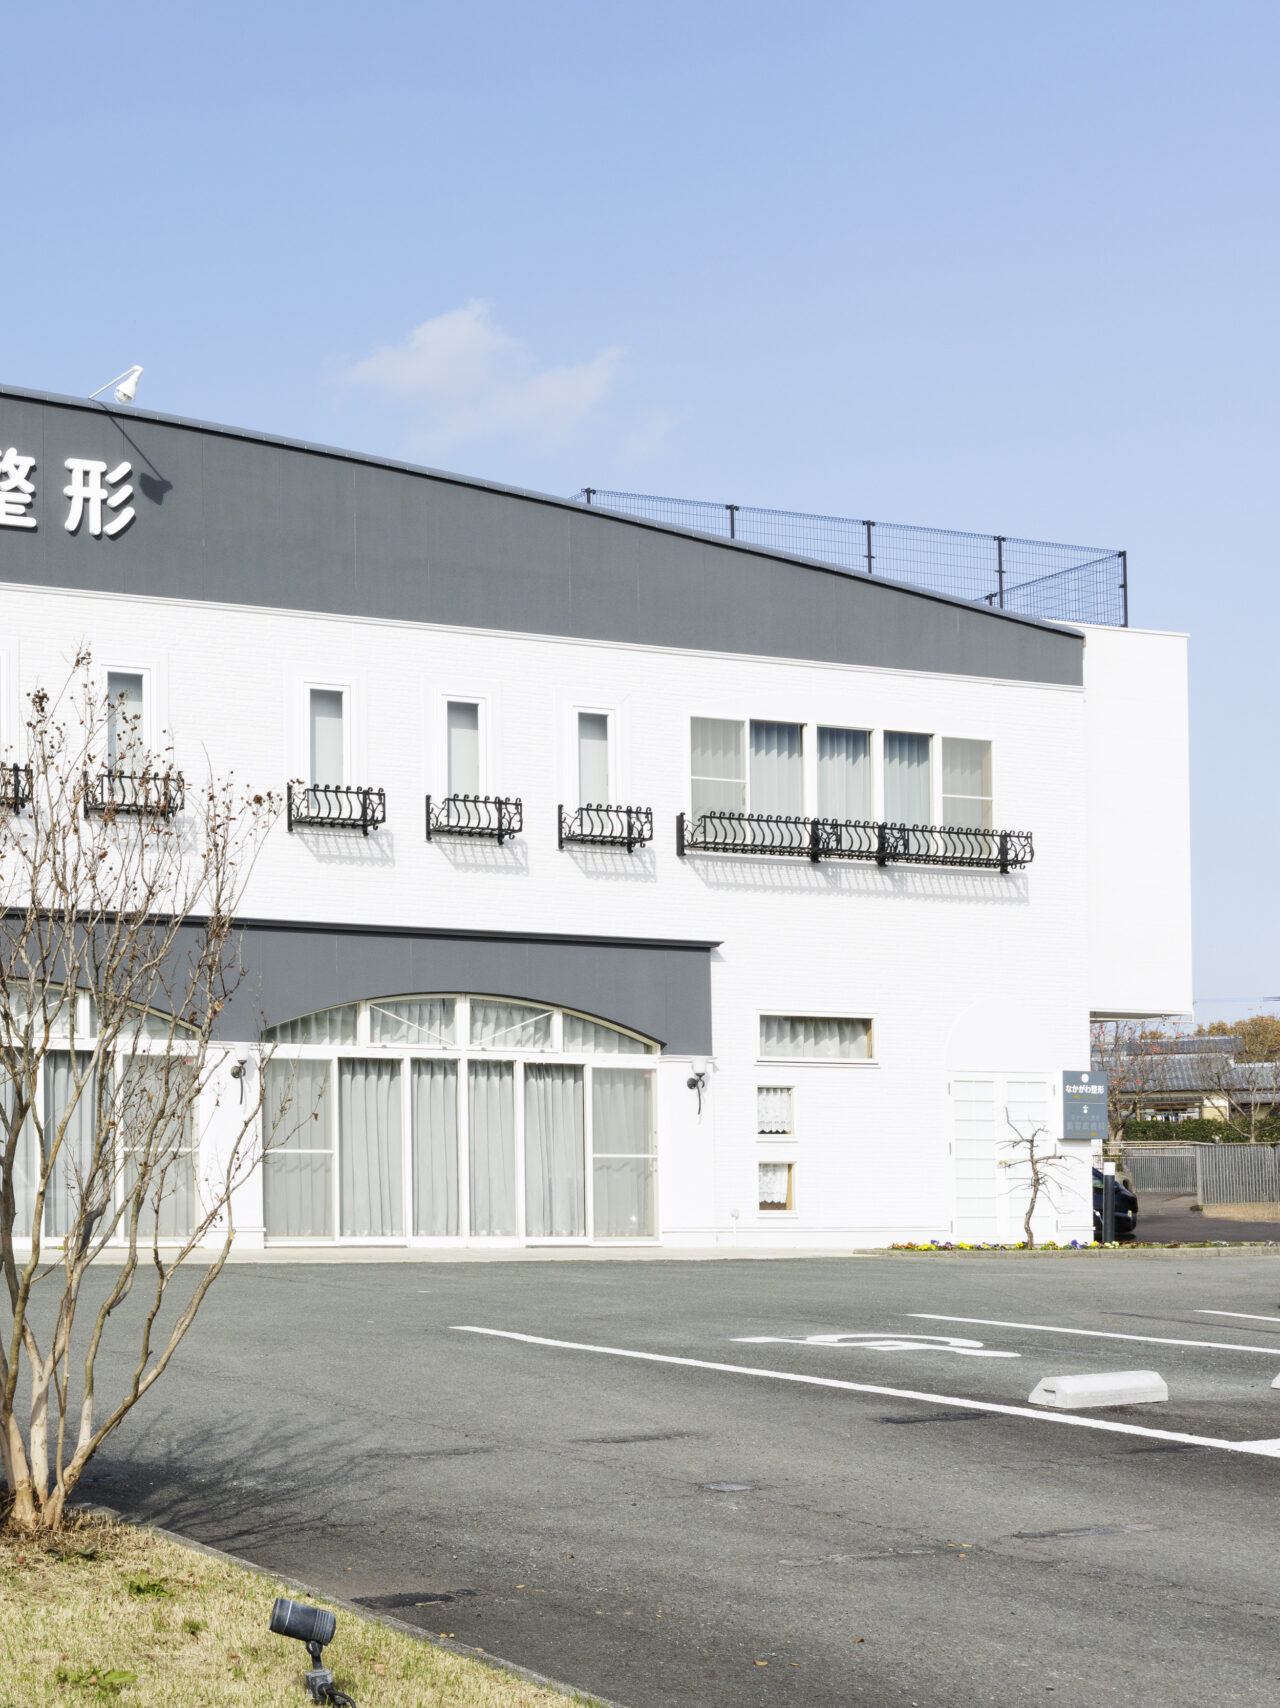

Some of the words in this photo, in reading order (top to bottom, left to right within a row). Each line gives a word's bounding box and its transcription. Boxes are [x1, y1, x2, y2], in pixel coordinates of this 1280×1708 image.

[1065, 1084, 1105, 1095] なかがわ整形
